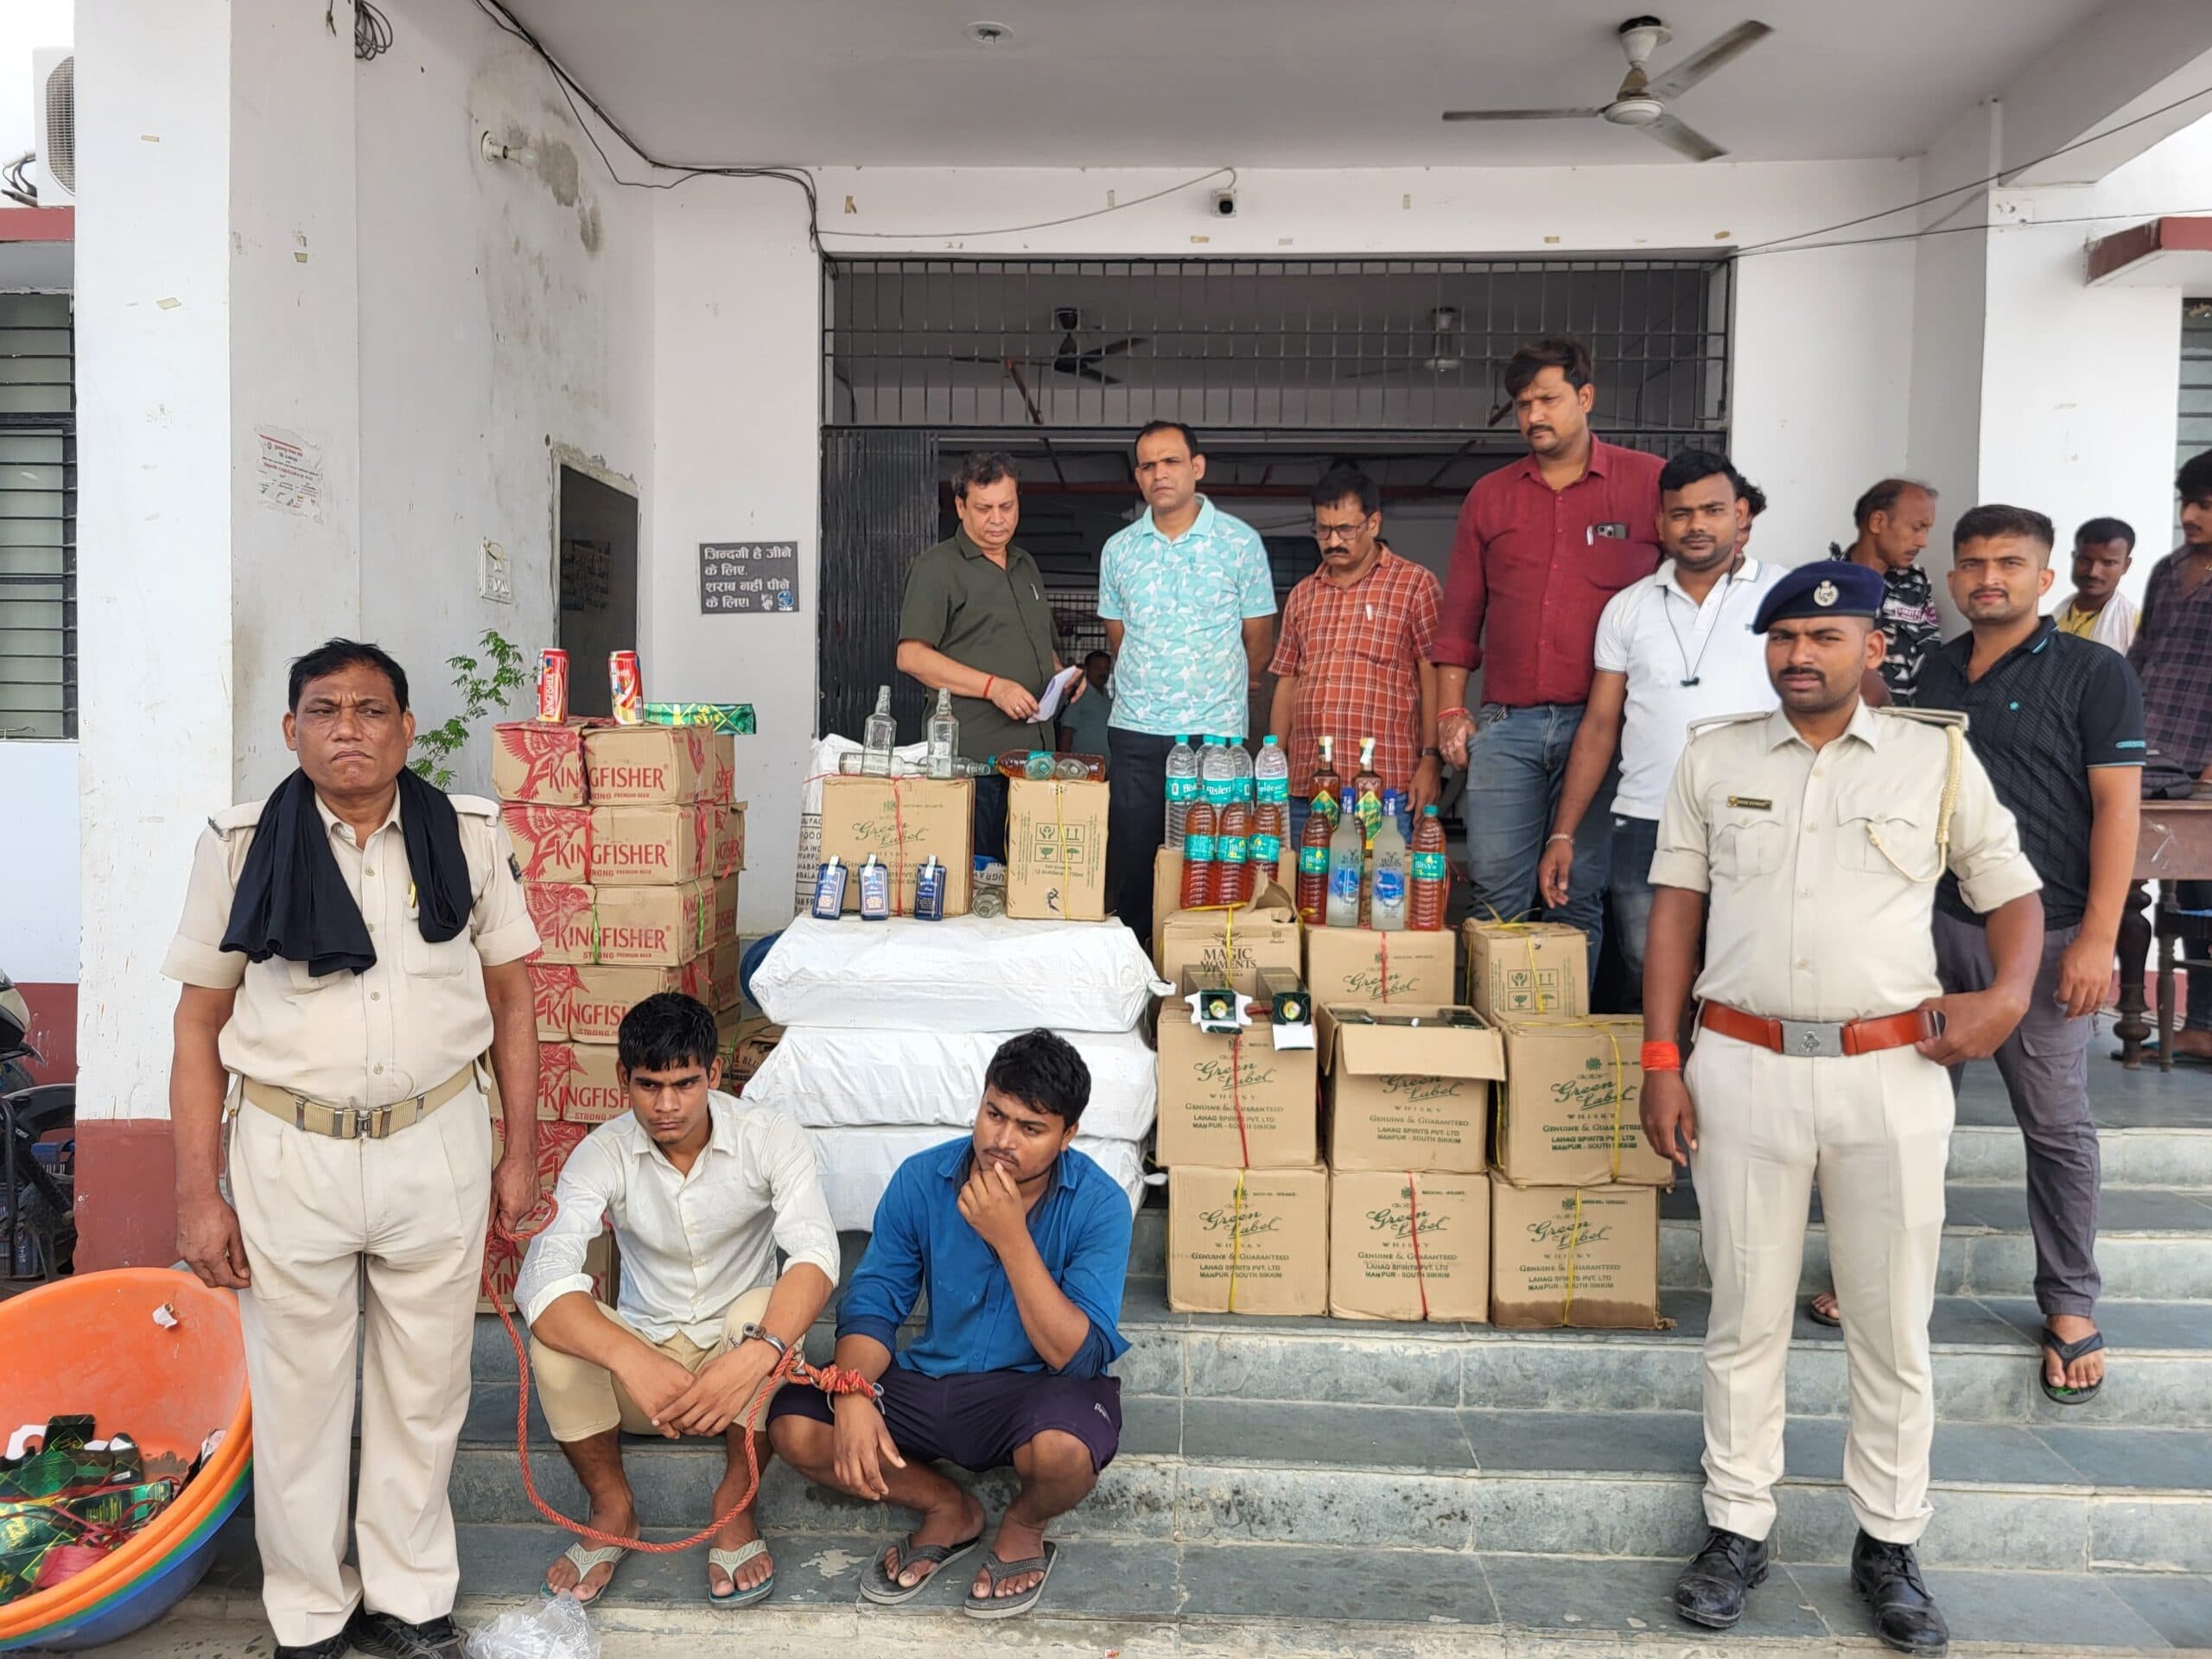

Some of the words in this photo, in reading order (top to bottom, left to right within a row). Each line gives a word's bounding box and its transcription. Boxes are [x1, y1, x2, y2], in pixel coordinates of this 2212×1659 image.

[753, 546, 762, 560] है
[766, 545, 792, 559] जीने
[704, 563, 718, 575] के
[705, 582, 736, 593] शराब
[740, 578, 762, 593] नहीं
[766, 578, 791, 590] पीने
[705, 596, 719, 608] के
[550, 761, 666, 793] KINGFISHER
[556, 839, 669, 870] KINGFISHER
[555, 923, 667, 952] KINGFISHER
[1200, 959, 1256, 969] MOMENTS
[1204, 948, 1253, 960] MAGIC
[1342, 972, 1402, 993] Green
[546, 998, 626, 1029] KINGFIS
[1193, 1060, 1257, 1082] Green
[543, 1082, 632, 1112] KINGFISH
[1404, 1081, 1465, 1099] Label
[1550, 1080, 1617, 1103] Green
[1576, 1085, 1637, 1107] Label
[575, 1112, 607, 1121] STRONG
[1198, 1210, 1263, 1230] Green
[1223, 1216, 1283, 1236] Label
[1366, 1208, 1431, 1230] Green
[1526, 1220, 1592, 1243] Green
